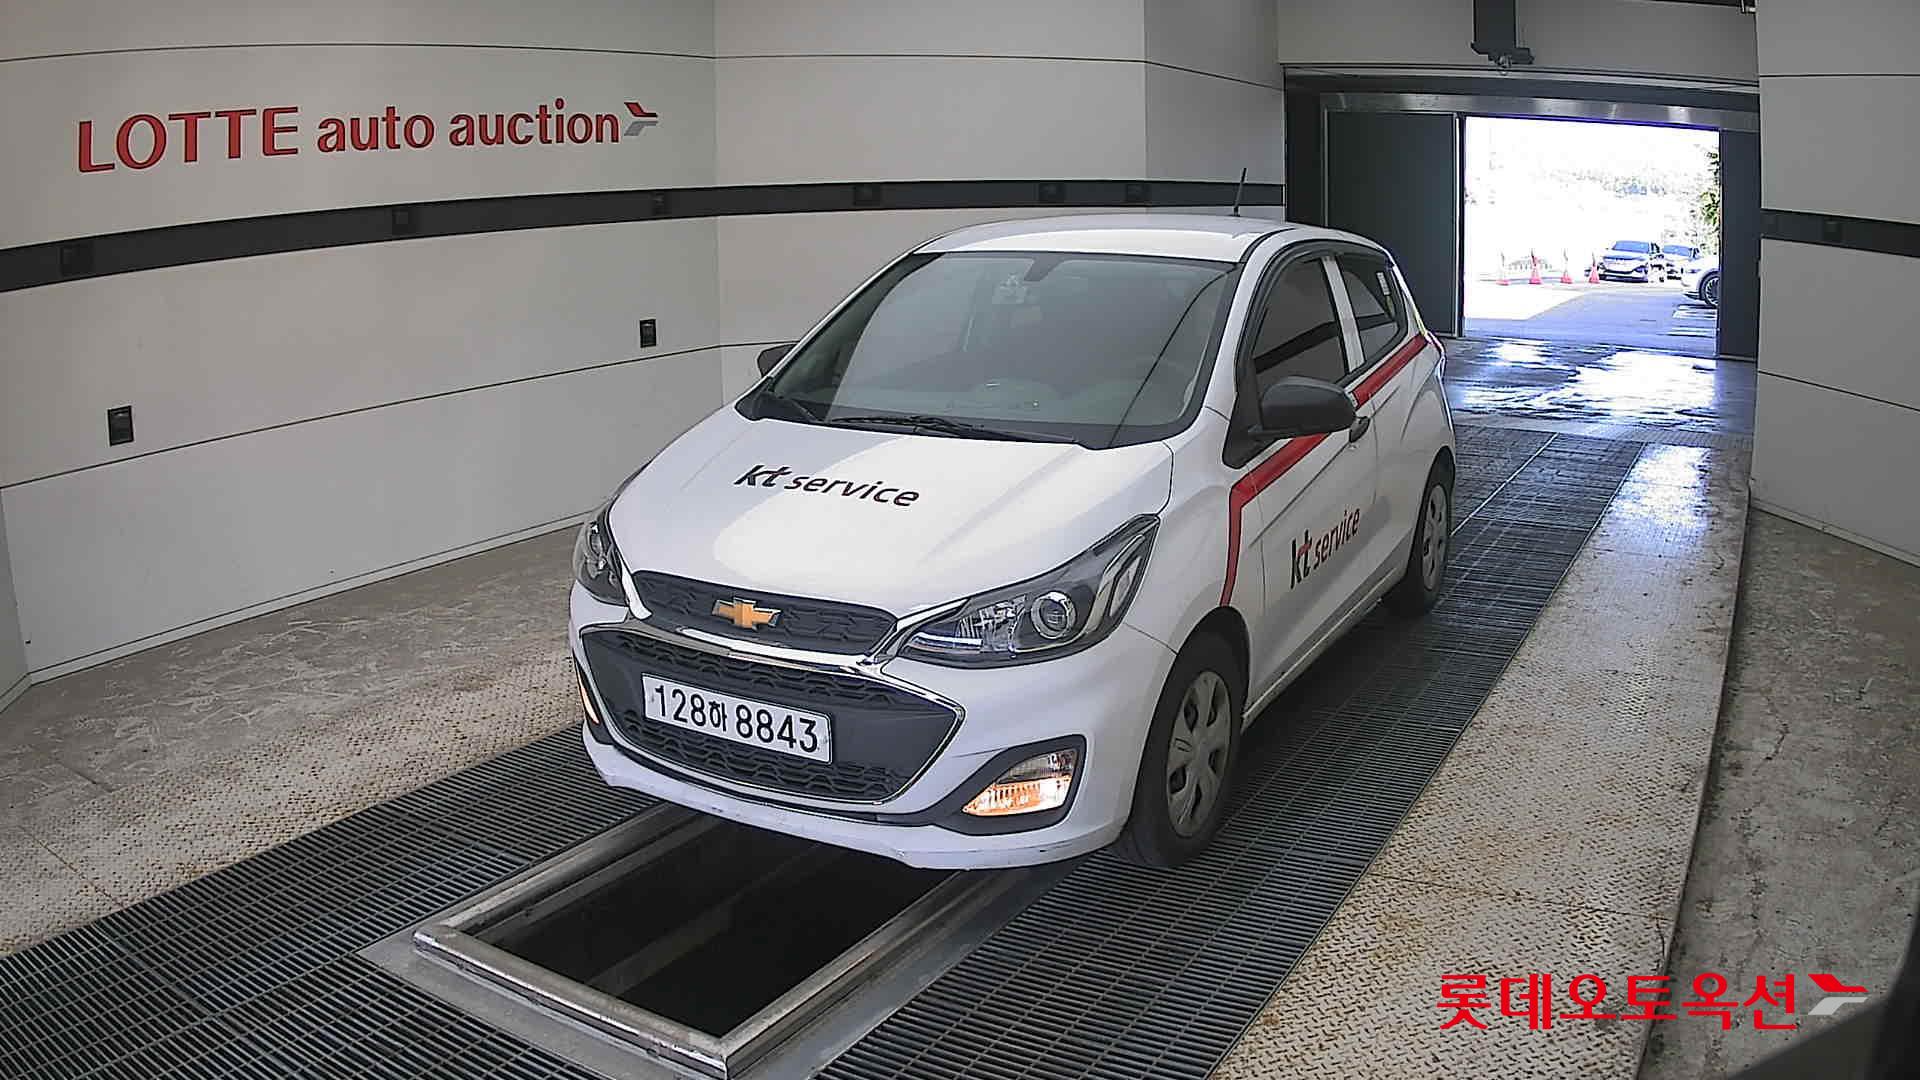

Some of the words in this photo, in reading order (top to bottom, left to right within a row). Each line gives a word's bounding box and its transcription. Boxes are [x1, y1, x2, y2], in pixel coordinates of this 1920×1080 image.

[78, 106, 300, 173] LOTTE
[317, 106, 436, 153] auto
[448, 98, 621, 147] auction
[734, 463, 792, 490] kt
[784, 472, 920, 508] service
[1290, 529, 1313, 590] kt
[1313, 508, 1361, 571] service
[653, 683, 728, 733] 128하
[734, 705, 820, 754] 8843
